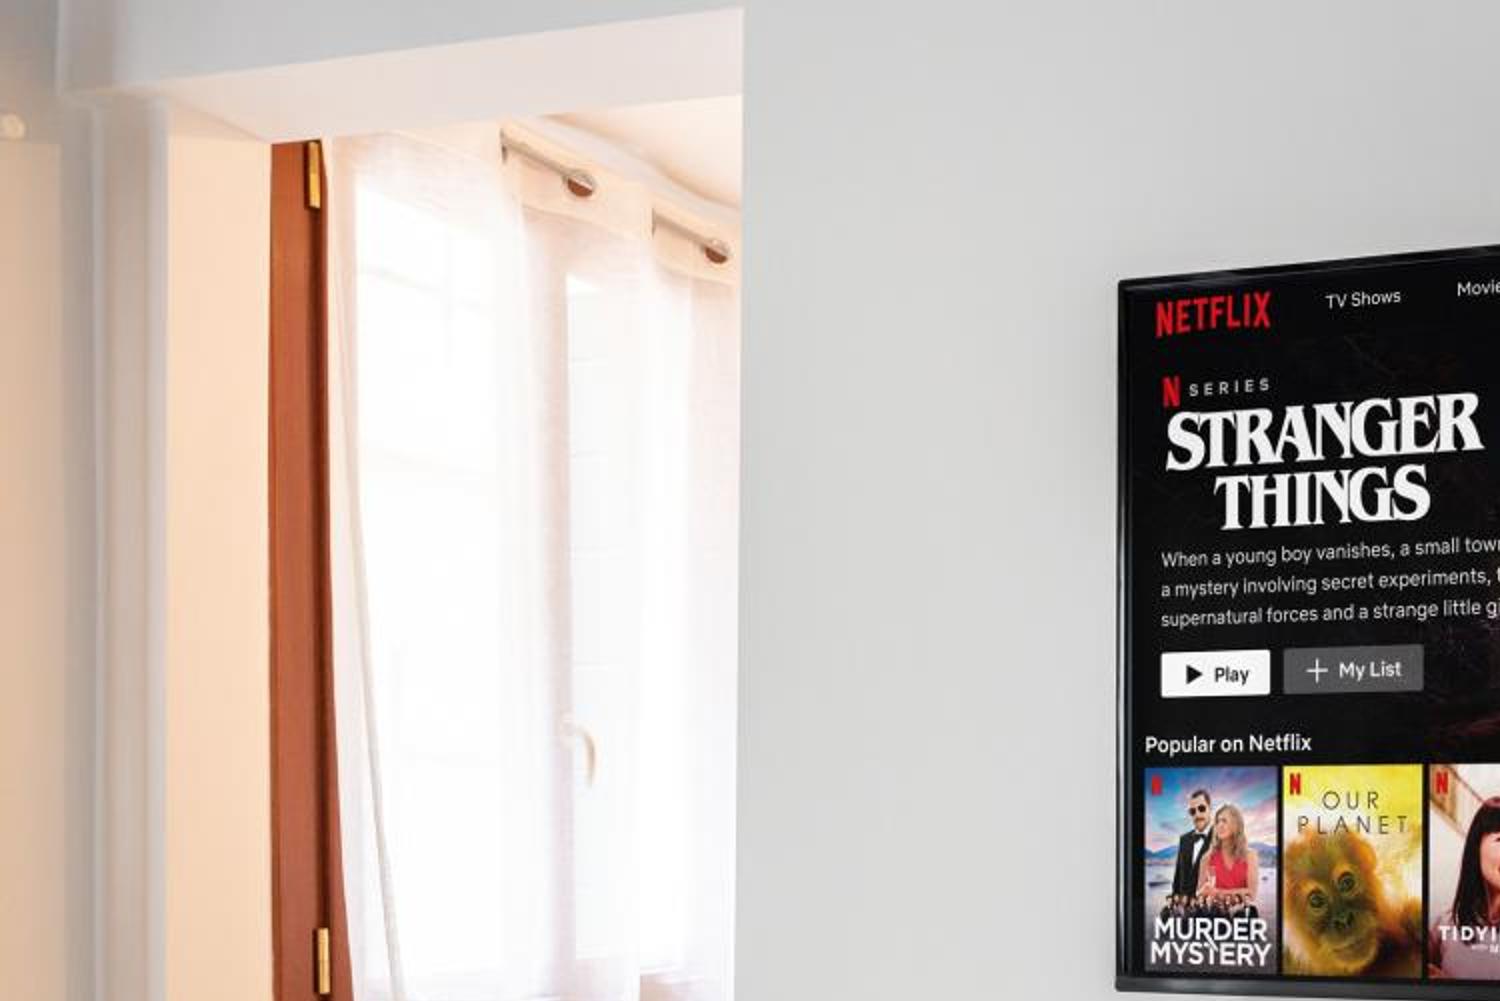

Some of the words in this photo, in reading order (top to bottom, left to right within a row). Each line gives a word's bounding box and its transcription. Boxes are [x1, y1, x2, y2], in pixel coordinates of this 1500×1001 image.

[1326, 294, 1347, 310] TV
[1352, 290, 1401, 308] Shows
[1155, 292, 1271, 339] NETFLIX
[1162, 375, 1180, 408] N
[1188, 377, 1270, 397] SERIES
[1165, 392, 1486, 472] STRANGER
[1213, 464, 1432, 531] THINGS
[1161, 551, 1208, 568] When
[1212, 553, 1221, 566] a
[1226, 549, 1277, 569] young
[1281, 545, 1313, 565] boy
[1316, 541, 1395, 560] vanishes,
[1400, 543, 1410, 556] a
[1415, 536, 1460, 556] small
[1161, 584, 1170, 598] a
[1175, 579, 1239, 600] mystery
[1243, 574, 1317, 595] involving
[1321, 571, 1374, 591] secret
[1379, 567, 1492, 591] experiments,
[1161, 606, 1263, 630] supernatural
[1266, 604, 1318, 623] forces
[1322, 603, 1354, 622] and
[1358, 606, 1369, 620] a
[1373, 601, 1438, 621] strange
[1443, 598, 1481, 616] little
[1214, 666, 1250, 685] Play
[1339, 661, 1365, 682] My
[1370, 659, 1402, 678] List
[1145, 735, 1215, 757] Popular
[1221, 738, 1243, 753] on
[1249, 733, 1312, 752] Netflix
[1289, 773, 1302, 795] N
[1435, 771, 1449, 795] N
[1322, 791, 1380, 811] OUR
[1297, 815, 1407, 835] PLANET
[1154, 917, 1268, 945] MURDER
[1151, 941, 1272, 967] MYSTERY
